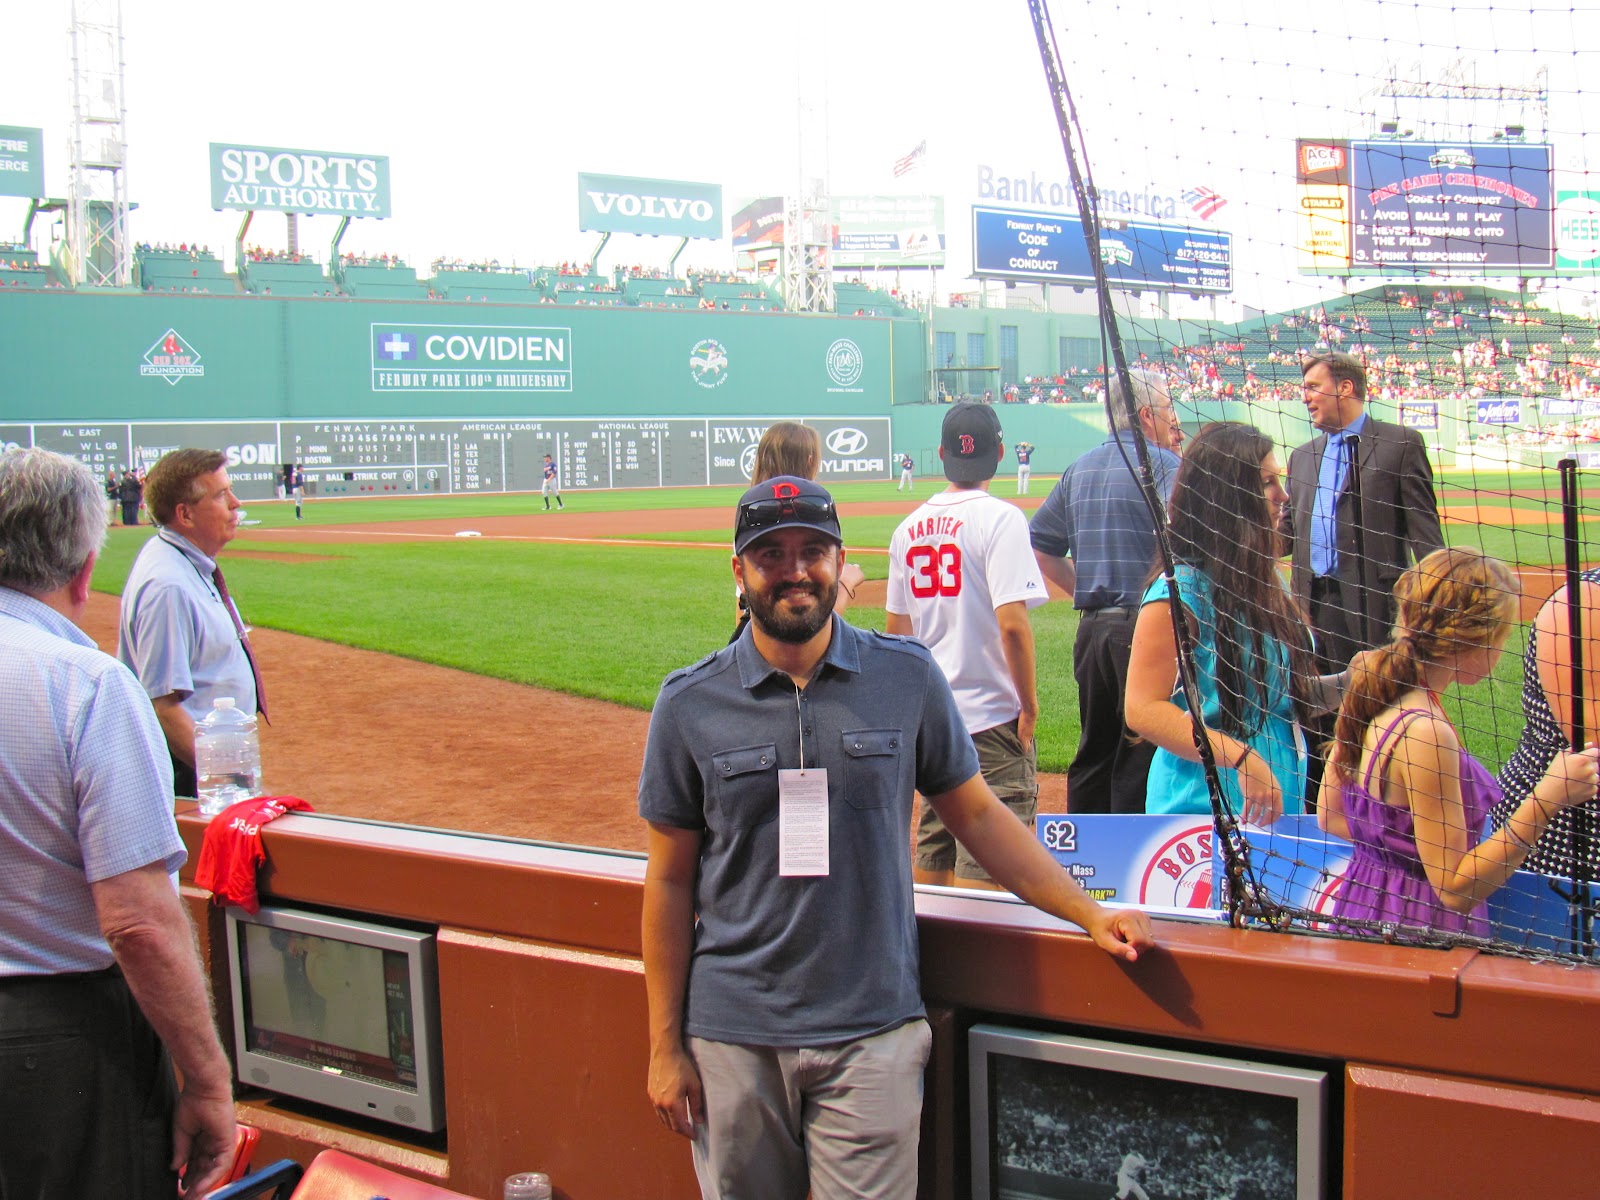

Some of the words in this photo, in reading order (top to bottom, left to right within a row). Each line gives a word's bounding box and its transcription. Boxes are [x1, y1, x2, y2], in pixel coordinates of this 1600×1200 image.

[1308, 148, 1338, 159] ACE
[221, 148, 377, 190] SPORTS
[977, 164, 1047, 204] Bank
[1401, 173, 1442, 190] GAME
[1445, 172, 1538, 208] CEREMONIES
[587, 191, 713, 221] VOLVO
[1303, 199, 1343, 208] STANLEY
[1415, 212, 1450, 221] BALLS
[1457, 212, 1468, 221] IN
[1475, 213, 1502, 221] PLAY
[1414, 226, 1470, 236] TRESPASS
[1474, 227, 1504, 236] ONTO
[1561, 219, 1599, 240] HESS
[1372, 236, 1395, 245] THE
[1399, 237, 1431, 246] FIELD
[1027, 248, 1040, 257] OF
[1412, 252, 1487, 261] RESPONSIBLY
[1009, 258, 1058, 271] CONDUCT
[425, 335, 564, 361] COVIDIEN
[153, 355, 170, 365] RED
[173, 355, 191, 365] SOX
[143, 366, 202, 374] FOUNDATION
[379, 373, 427, 386] FENWAY
[432, 373, 461, 386] PARK
[465, 374, 492, 387] 100th
[496, 374, 566, 387] ANNIVERSARY
[1403, 405, 1434, 415] GIANT
[1402, 416, 1435, 426] GLASS
[314, 425, 370, 433] FENWAY
[381, 424, 416, 432] PARK
[80, 442, 91, 450] W
[95, 442, 101, 450] L
[959, 434, 975, 454] B
[305, 456, 332, 464] BOSTON
[714, 456, 736, 467] Since
[819, 459, 883, 472] YUNDAI
[253, 472, 273, 481] 1898
[307, 474, 319, 482] BAT
[326, 473, 345, 481] BALL
[353, 472, 379, 480] STRIKE
[381, 472, 397, 480] OUT
[908, 516, 965, 542] VARITEK
[906, 543, 962, 598] 33
[1044, 821, 1076, 850] $2
[1072, 865, 1094, 876] Mass
